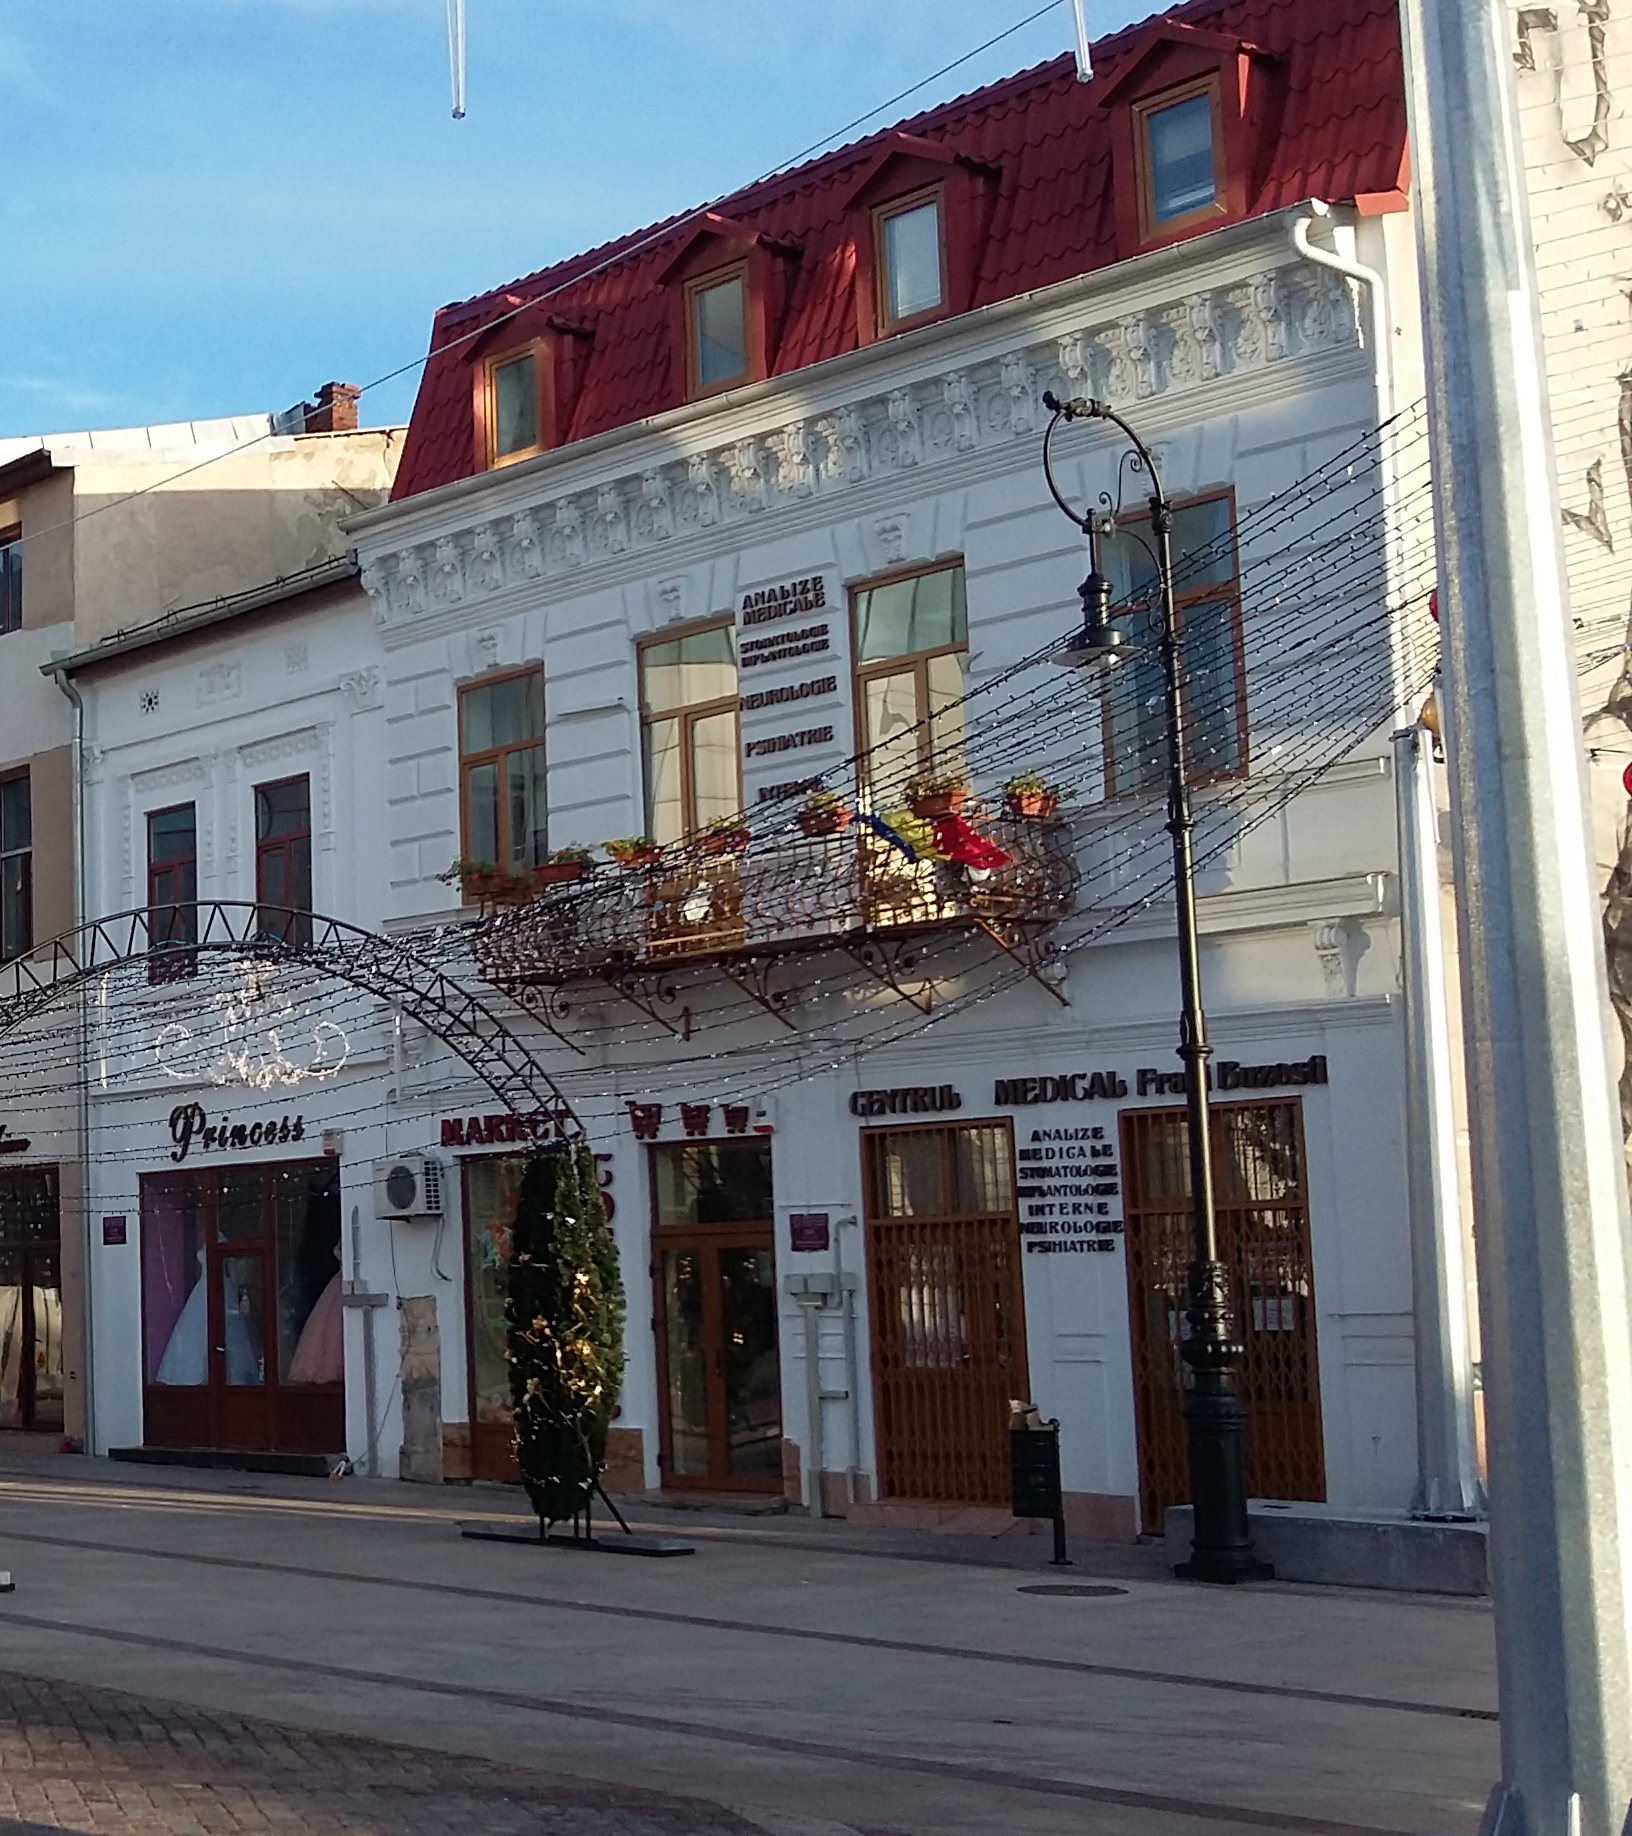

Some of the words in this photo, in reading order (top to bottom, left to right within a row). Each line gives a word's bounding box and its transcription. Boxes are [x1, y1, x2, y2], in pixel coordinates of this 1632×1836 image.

[742, 575, 825, 611] ANALIZE
[743, 591, 826, 626] MEDICALE
[739, 675, 837, 711] NEUROLOGIE
[745, 725, 834, 758] PSIHIATRIE
[849, 1084, 962, 1117] CENTRUL
[994, 1071, 1128, 1106] MEDICAL
[169, 1101, 305, 1162] Princess
[441, 1109, 572, 1147] MARKET
[1030, 1127, 1105, 1142] ANALIZE
[1018, 1144, 1114, 1161] MEDICALE
[1019, 1163, 1119, 1179] STOMATOLOGIE
[1028, 1202, 1110, 1217] INTERNE
[1019, 1220, 1124, 1235] NEUROLOGIE
[1026, 1239, 1116, 1253] PSIHIATRIE
